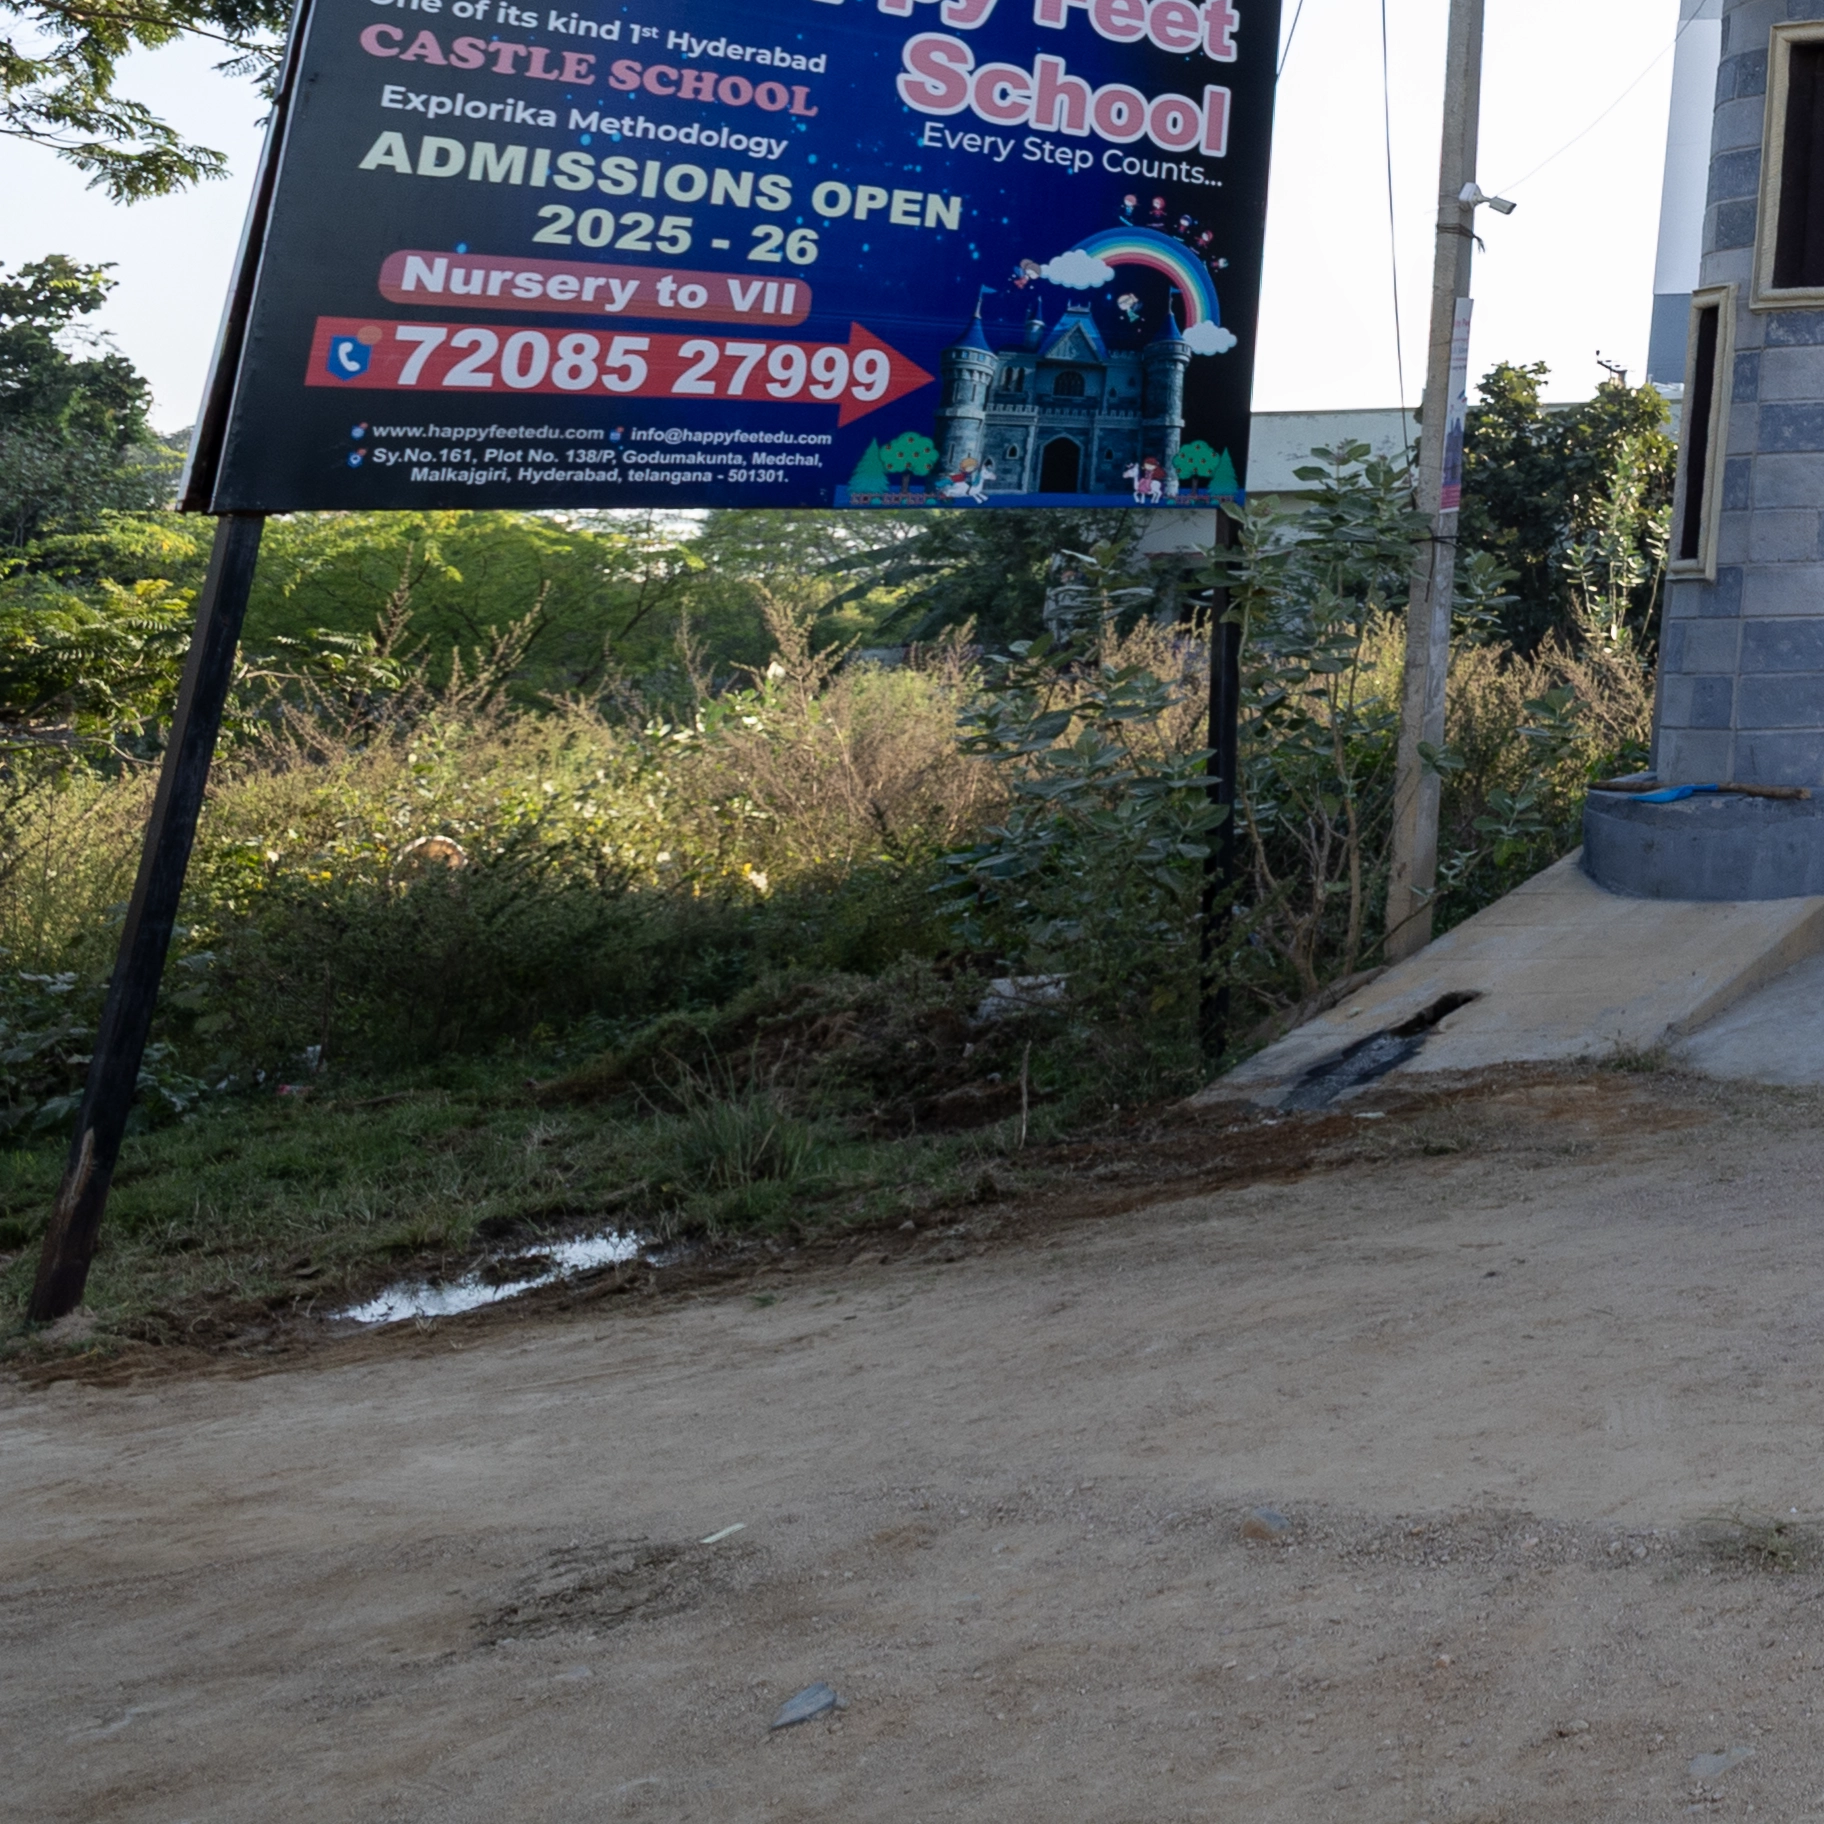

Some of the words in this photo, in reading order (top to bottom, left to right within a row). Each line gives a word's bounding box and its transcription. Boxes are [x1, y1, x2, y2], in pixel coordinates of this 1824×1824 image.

[359, 23, 597, 85] CASTLE
[608, 59, 819, 117] SCHOOL
[497, 5, 538, 28] its
[547, 10, 620, 41] kind
[629, 24, 659, 45] 1st
[667, 30, 827, 74] Hyderabad
[380, 84, 558, 127] Explorika
[567, 108, 788, 161] Methodology
[896, 31, 1230, 157] School
[358, 130, 793, 212] ADMISSIONS
[810, 180, 962, 230] OPEN
[922, 122, 1015, 162] Every
[1022, 136, 1094, 171] Step
[1101, 146, 1223, 187] Counts...
[531, 203, 693, 255] 2025
[747, 224, 819, 266] 26
[400, 254, 640, 313] Nursery
[656, 274, 709, 310] to
[727, 278, 797, 315] VII
[394, 325, 650, 393] 72085
[671, 338, 891, 402] 27999
[372, 423, 604, 440] www.happyfeetedu.com
[372, 447, 478, 466] Sy.No.161,
[484, 447, 523, 463] Plot
[527, 448, 559, 463] No.
[566, 448, 617, 466] 138/P,
[622, 450, 747, 466] Godumakunta,
[752, 452, 823, 467] Medchal,
[630, 427, 832, 445] info@happyfeetedu.com
[410, 467, 511, 485] Malkajgiri,
[518, 467, 622, 485] Hyderabad,
[627, 468, 712, 485] telangana
[728, 468, 789, 482] 501301.
